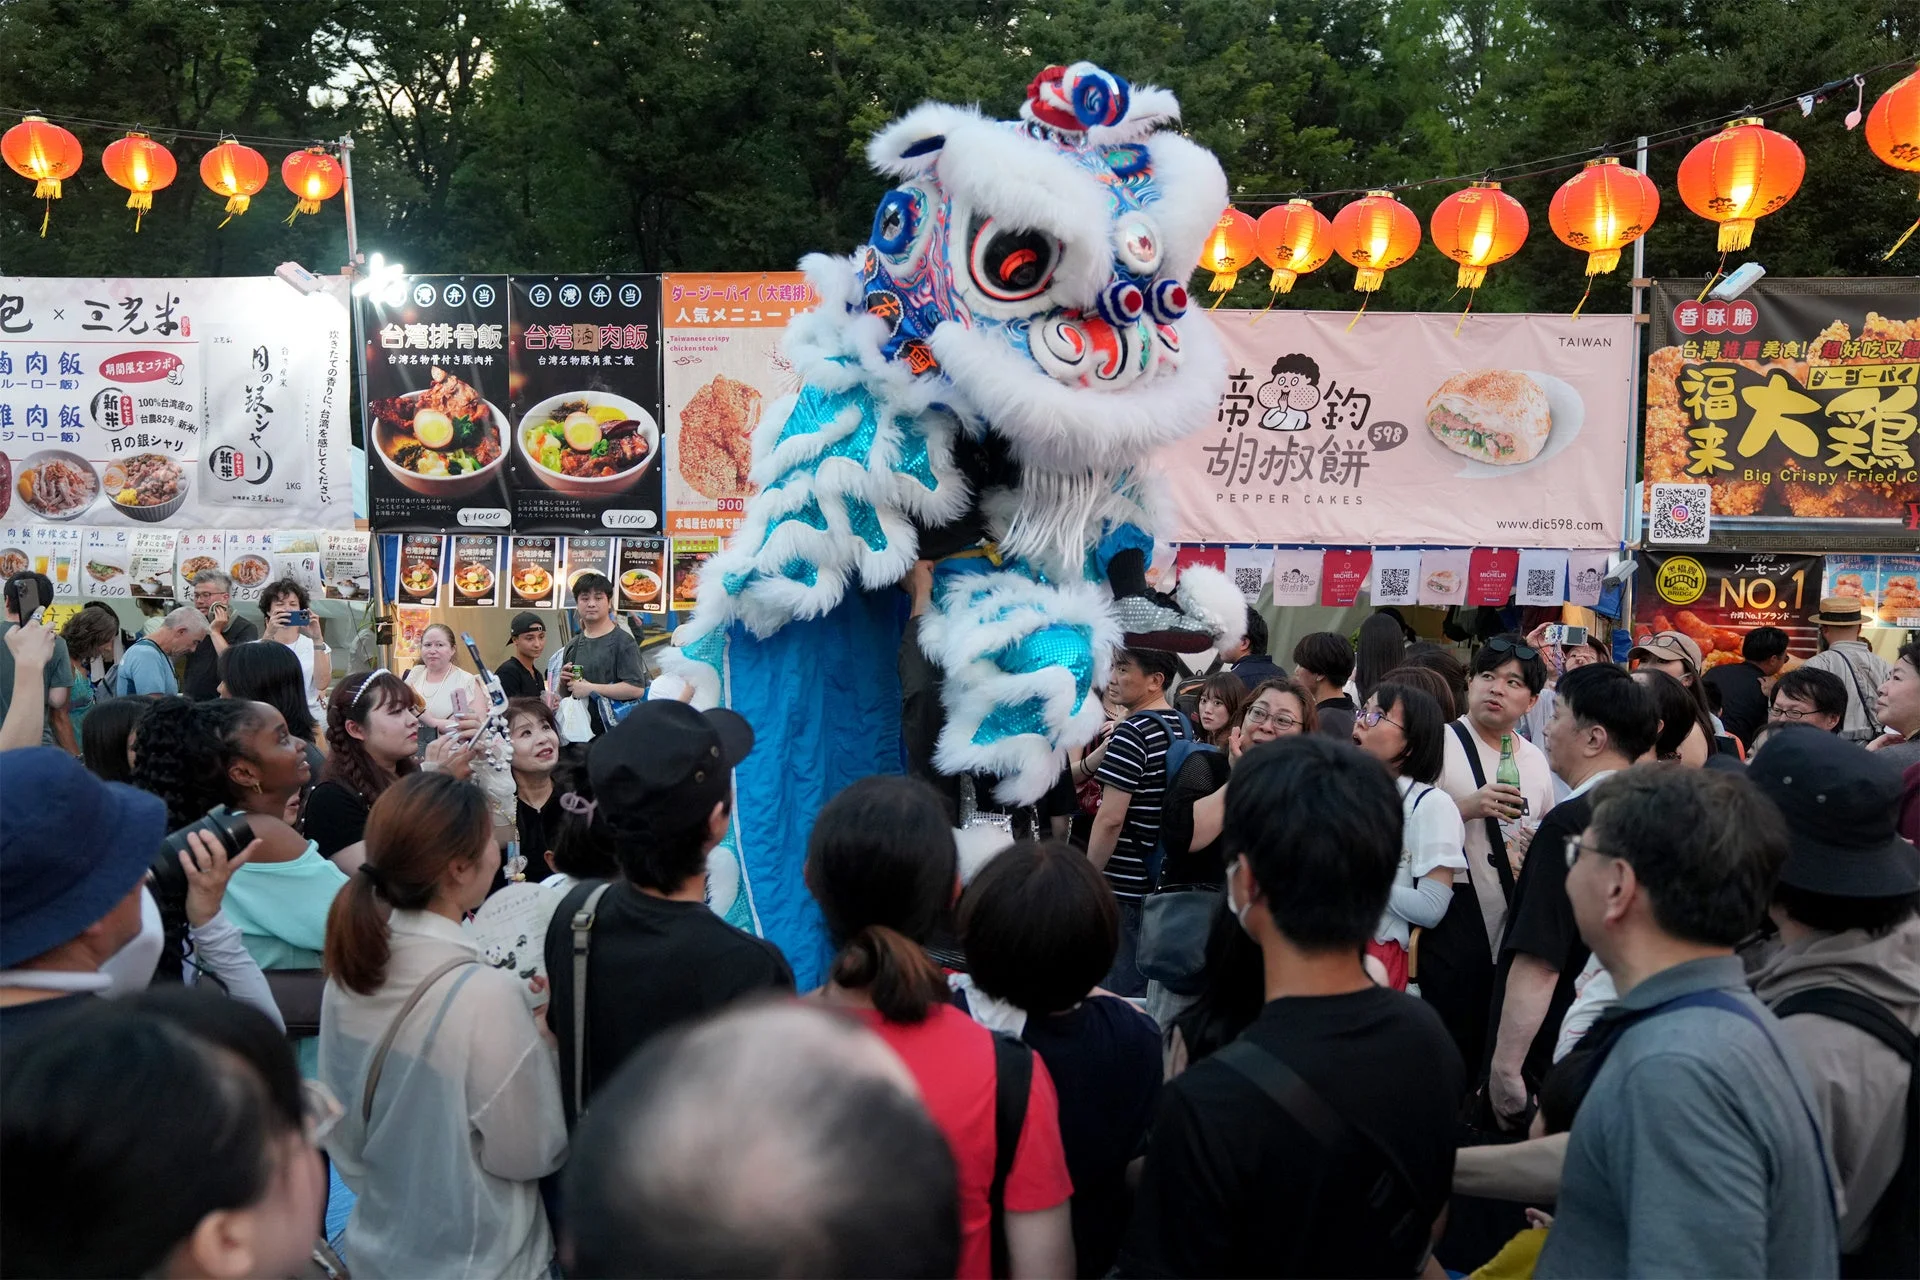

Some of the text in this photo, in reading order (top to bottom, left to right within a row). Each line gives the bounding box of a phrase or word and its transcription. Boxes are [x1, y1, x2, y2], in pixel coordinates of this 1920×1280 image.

[1679, 308, 1752, 327] 香酥脆
[380, 323, 503, 350] 台湾排骨飯
[1558, 337, 1612, 348] TAIWAN
[105, 358, 176, 375] 期間限定コラボ!
[1811, 366, 1914, 387] ダージーパイ
[103, 394, 118, 428] 新米
[1373, 426, 1402, 443] 598
[219, 450, 232, 478] 新米
[1202, 432, 1370, 488] 胡椒餅
[286, 482, 301, 490] 1KG
[1744, 470, 1771, 483] Big
[1780, 470, 1838, 485] Crispy
[1848, 470, 1897, 483] Fried
[718, 499, 743, 511] 900
[1216, 493, 1362, 504] PEPPER CAKES
[1497, 518, 1603, 531] www.dic598.com
[1734, 563, 1791, 575] ソーセージ
[1719, 569, 1806, 609] NO.1
[1730, 612, 1790, 620] 台湾No.1ブランド
